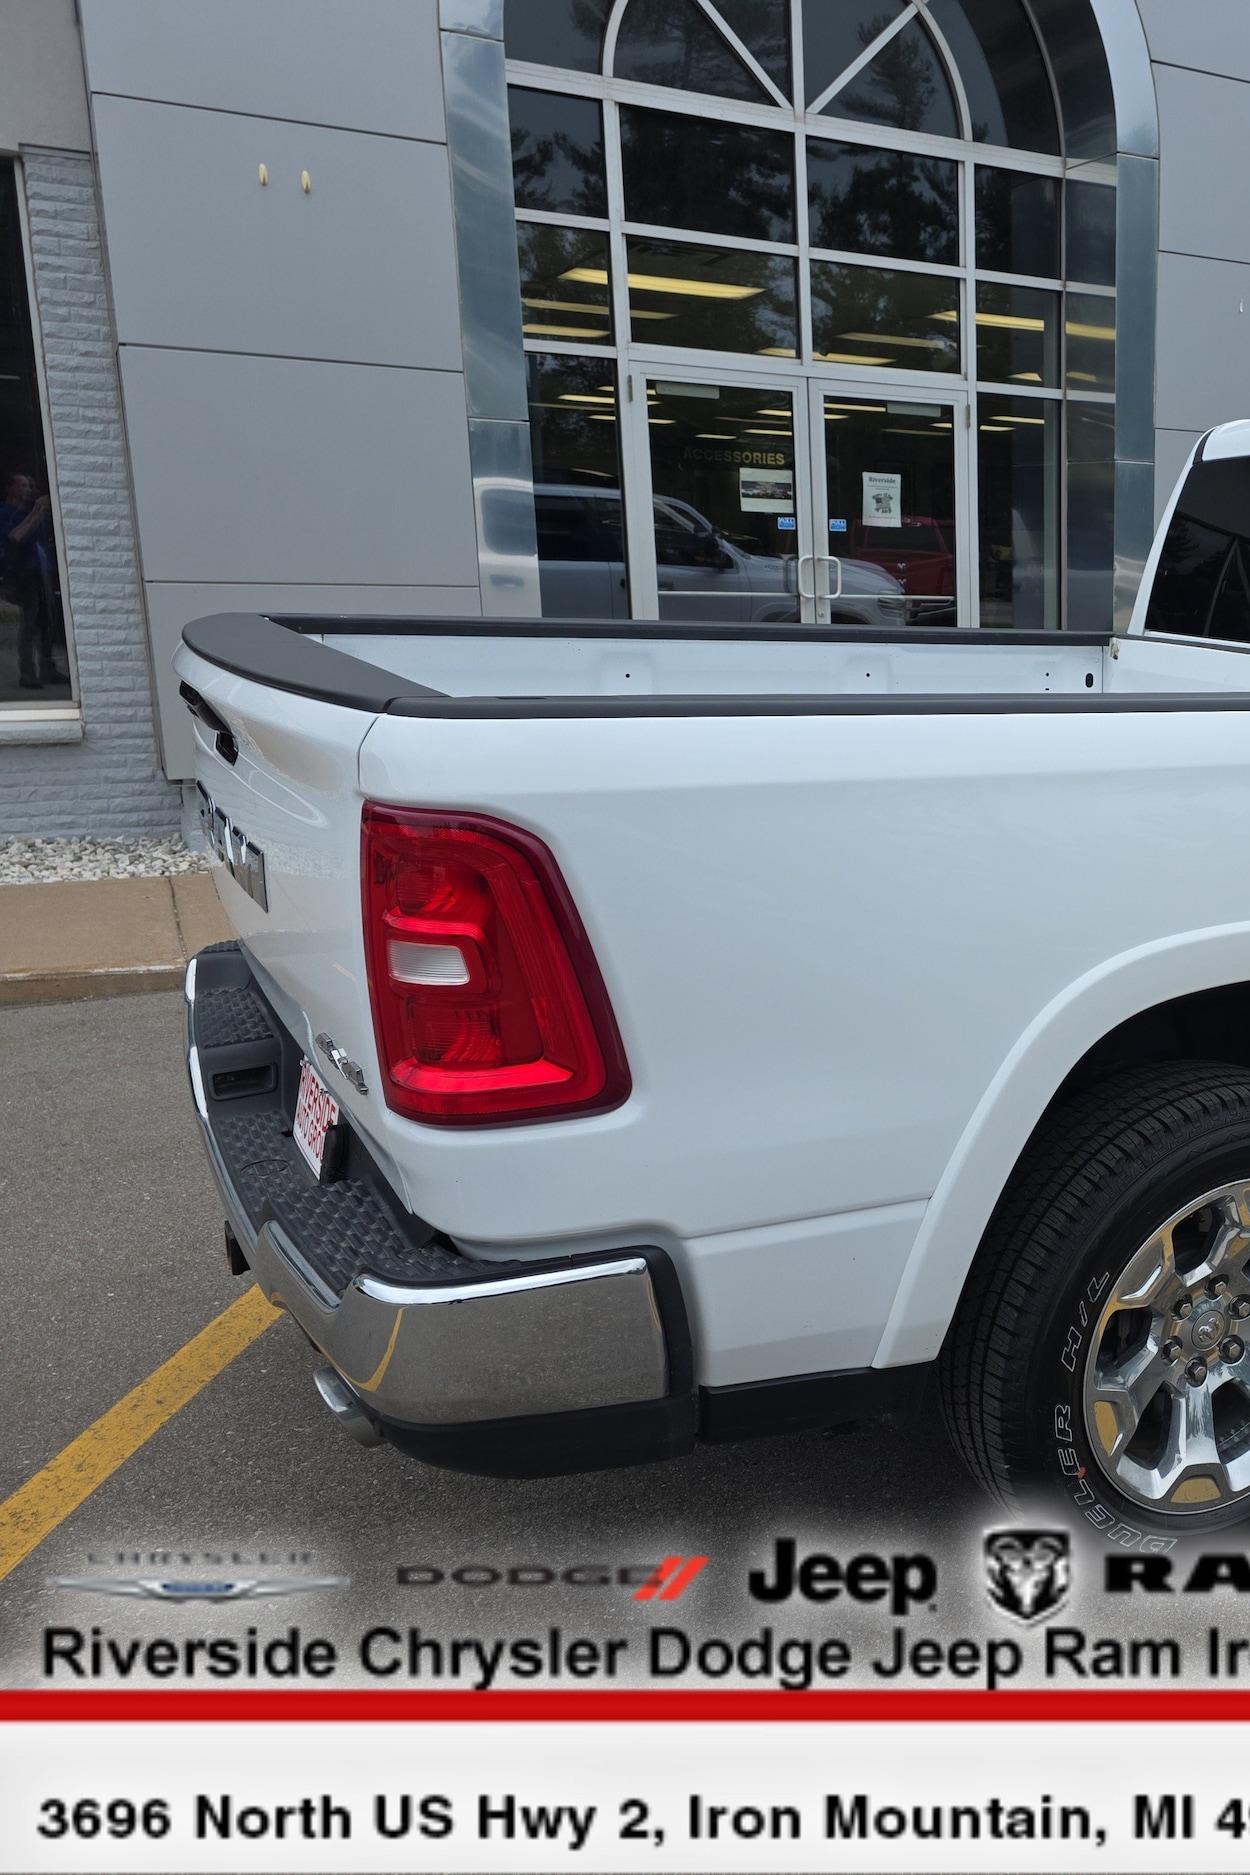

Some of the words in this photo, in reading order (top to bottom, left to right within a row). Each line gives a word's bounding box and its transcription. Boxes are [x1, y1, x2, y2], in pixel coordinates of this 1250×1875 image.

[683, 447, 786, 465] ACCESSORIES
[300, 1063, 338, 1134] RIVERSIDE
[1053, 1402, 1179, 1554] DUELER
